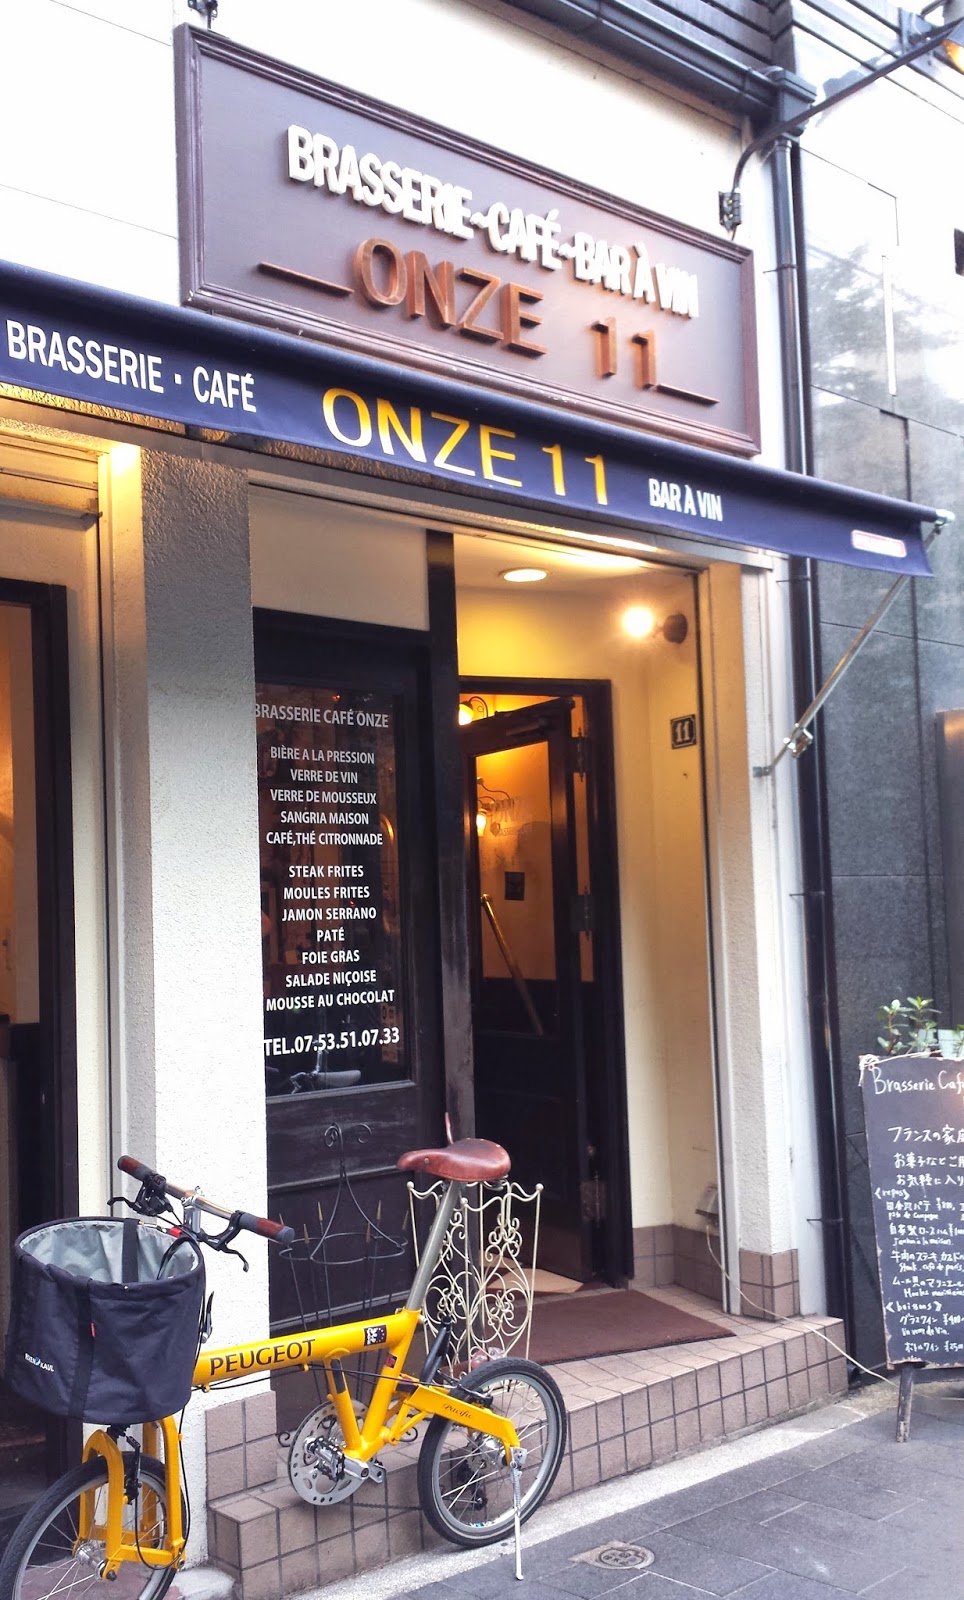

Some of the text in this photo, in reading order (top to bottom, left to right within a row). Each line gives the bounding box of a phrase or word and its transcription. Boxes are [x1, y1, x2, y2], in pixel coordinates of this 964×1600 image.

[287, 124, 475, 240] BRASSERIE
[487, 202, 562, 270] CAFÉ
[573, 231, 632, 296] BAR
[654, 262, 699, 319] VIN
[353, 237, 657, 390] ONZE 11
[6, 319, 257, 413] BRASSERIE CAFÉ
[322, 387, 608, 506] ONZE 11
[648, 478, 723, 522] BAR À VIN
[255, 703, 389, 728] BRASSERIE CAFÉ ONZE
[675, 720, 691, 743] 11
[270, 744, 375, 765] BIÈRE A LA PRESSION
[290, 768, 358, 784] VERRE DE VIN
[270, 789, 377, 805] VERRE DE MOUSSEUX
[280, 811, 369, 825] SANGRIA MAISON
[318, 832, 383, 845] CITRONNADE
[288, 865, 364, 878] STEAK FRITES
[283, 886, 370, 900] MOULES FRITES
[282, 907, 377, 922] JAMON SERRANO
[316, 926, 345, 942] PATÉ
[302, 949, 360, 965] FOIE GRAS
[285, 970, 377, 988] SALADE NIÇOISE
[266, 989, 395, 1011] MOUSSE AU CHOCOLAT
[872, 1066, 936, 1095] Brasserie
[209, 1338, 316, 1376] PEUGEOT
